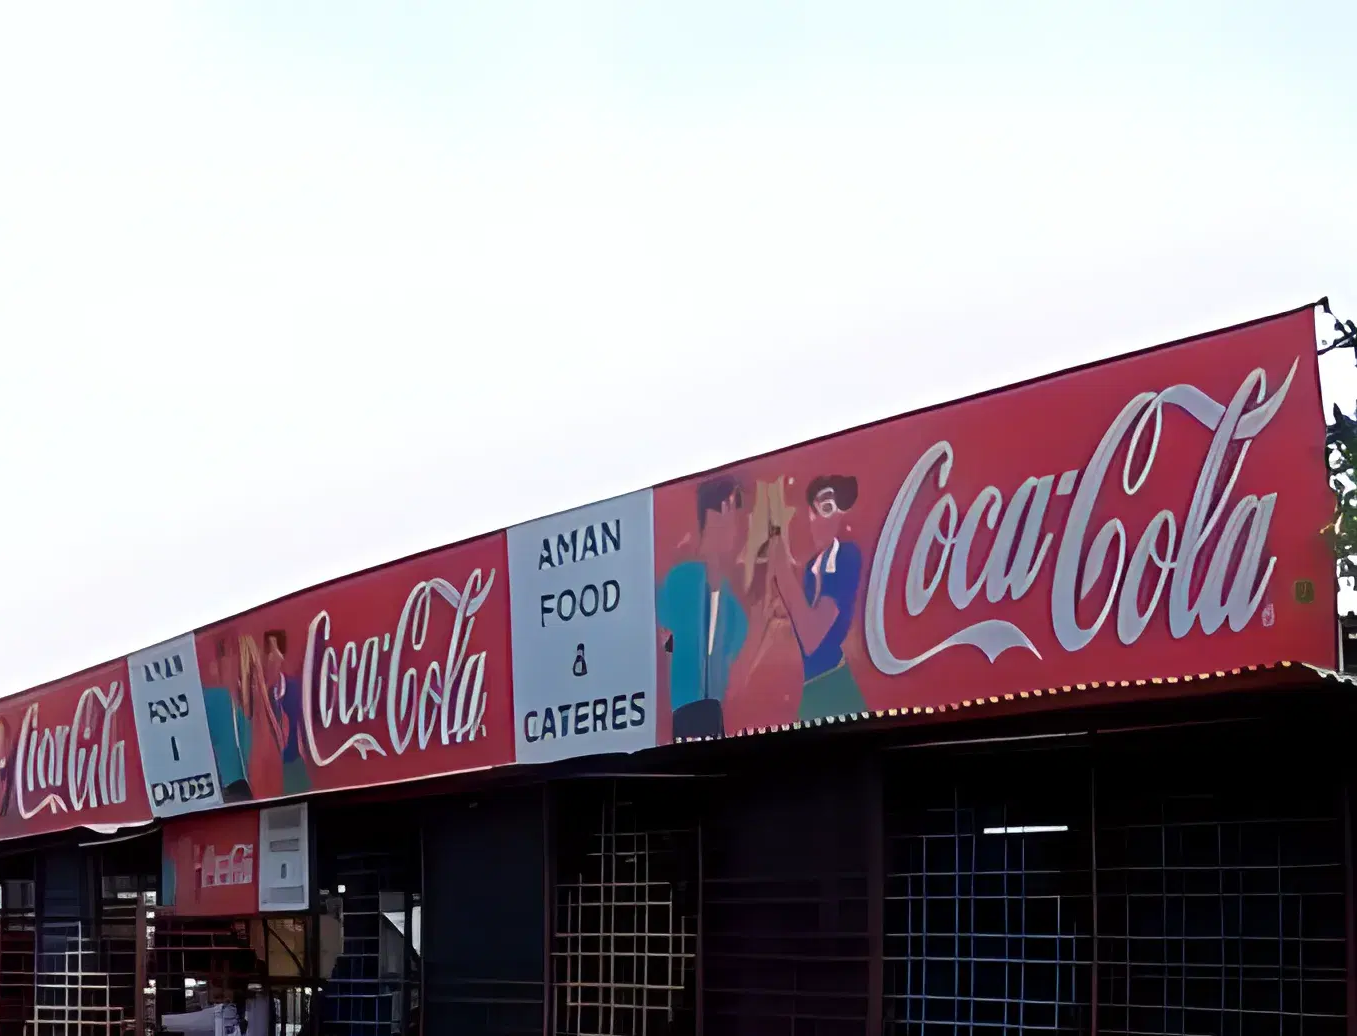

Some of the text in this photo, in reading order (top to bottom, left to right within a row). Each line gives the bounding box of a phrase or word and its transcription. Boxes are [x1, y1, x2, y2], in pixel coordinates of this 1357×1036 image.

[866, 356, 1299, 675] Coca-Cola
[539, 519, 621, 570] AMAN
[541, 580, 621, 627] FOOD
[302, 567, 495, 766] Coca-Cola
[524, 692, 646, 743] CATERES
